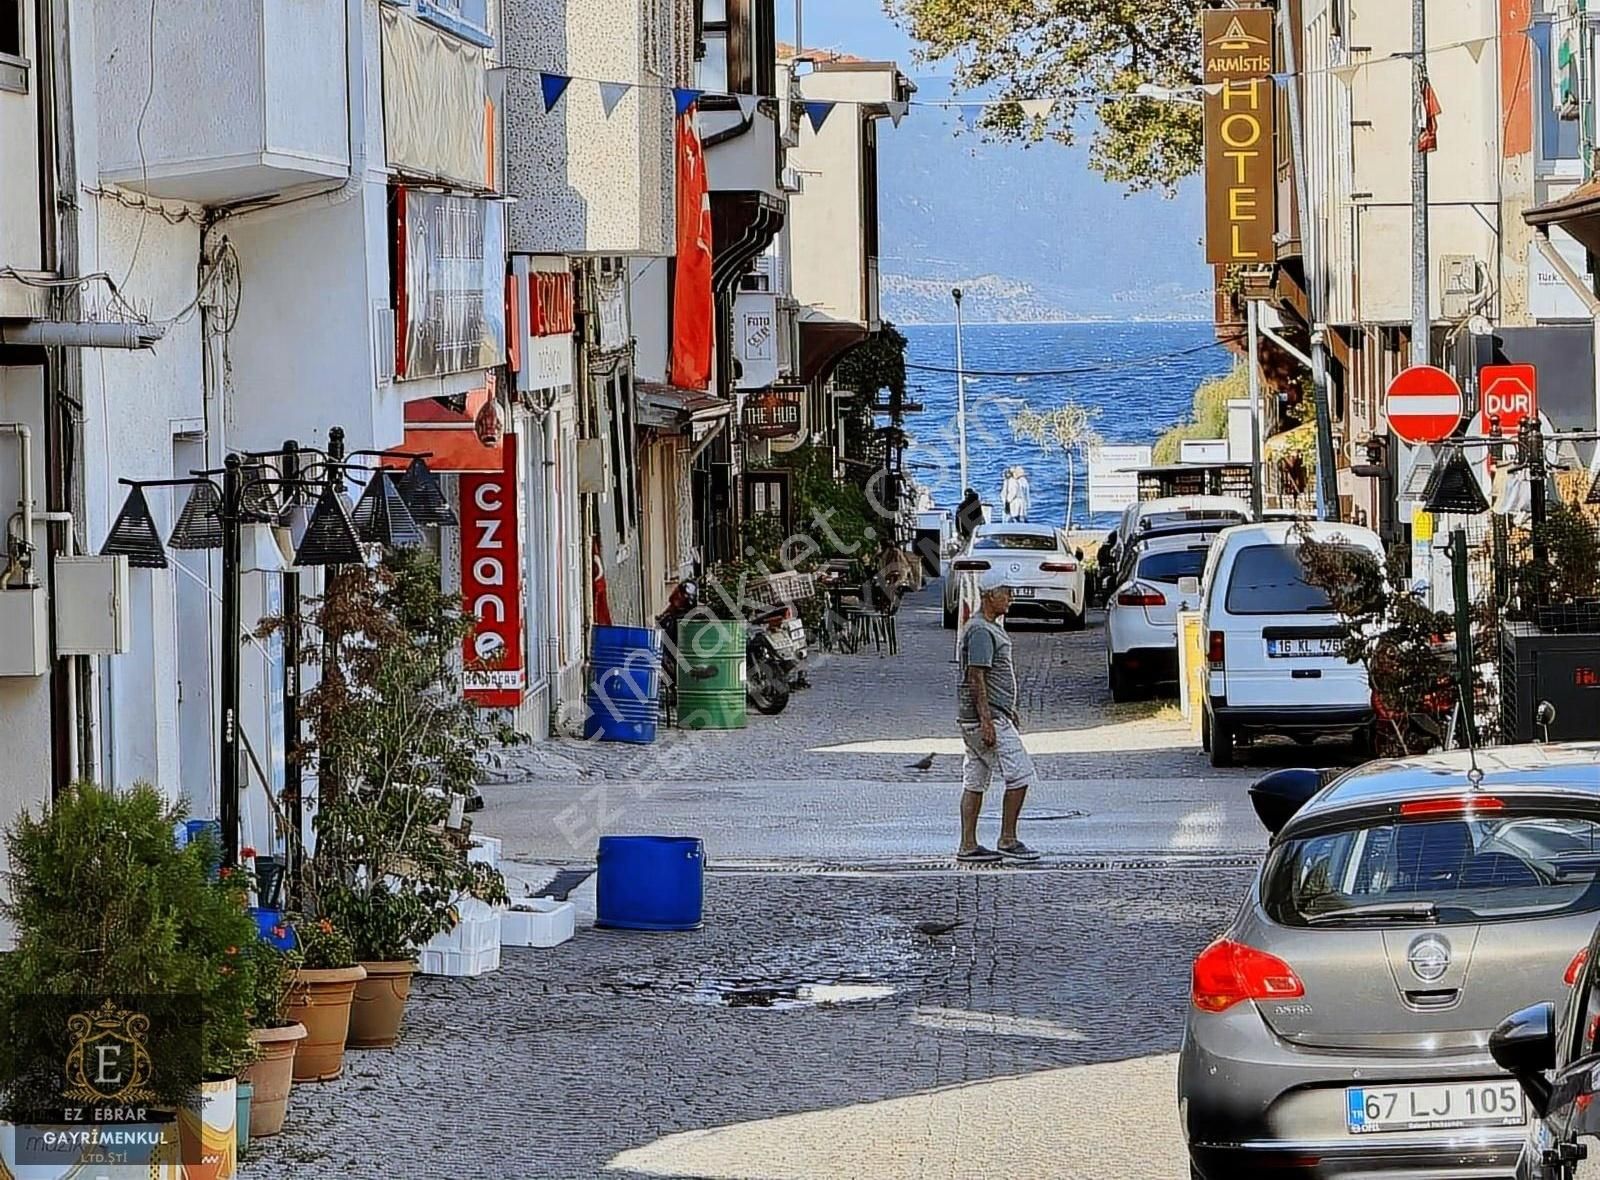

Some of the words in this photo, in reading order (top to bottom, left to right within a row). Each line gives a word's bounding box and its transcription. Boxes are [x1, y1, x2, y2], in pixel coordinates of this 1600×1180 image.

[1220, 77, 1261, 258] HOTEL
[744, 407, 768, 425] THE
[773, 406, 798, 423] HUB
[1488, 393, 1528, 414] DUR
[1366, 1093, 1398, 1119] 67
[1410, 1090, 1450, 1116] LJ
[1466, 1087, 1516, 1114] 105
